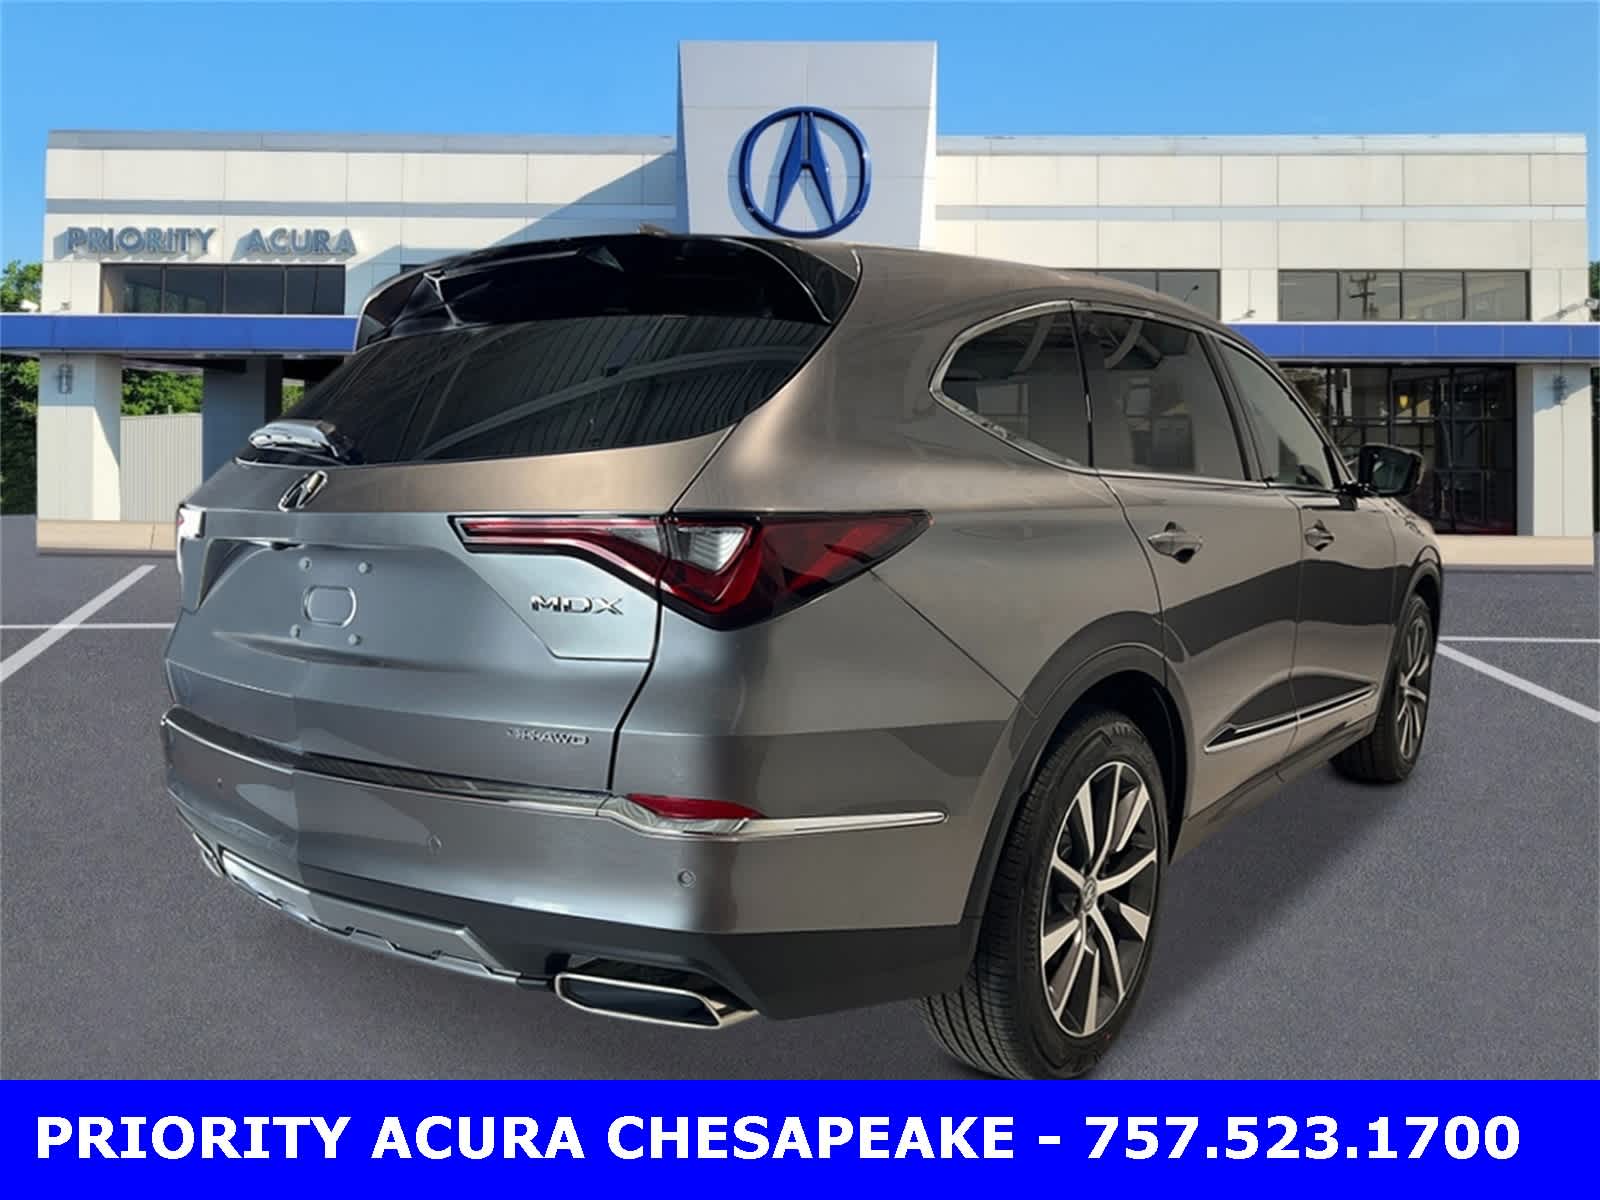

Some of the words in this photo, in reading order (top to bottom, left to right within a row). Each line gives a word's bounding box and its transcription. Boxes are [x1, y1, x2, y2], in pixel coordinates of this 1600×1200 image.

[66, 227, 216, 253] PRIORITY
[246, 228, 357, 253] ACURA
[530, 595, 623, 615] MDX
